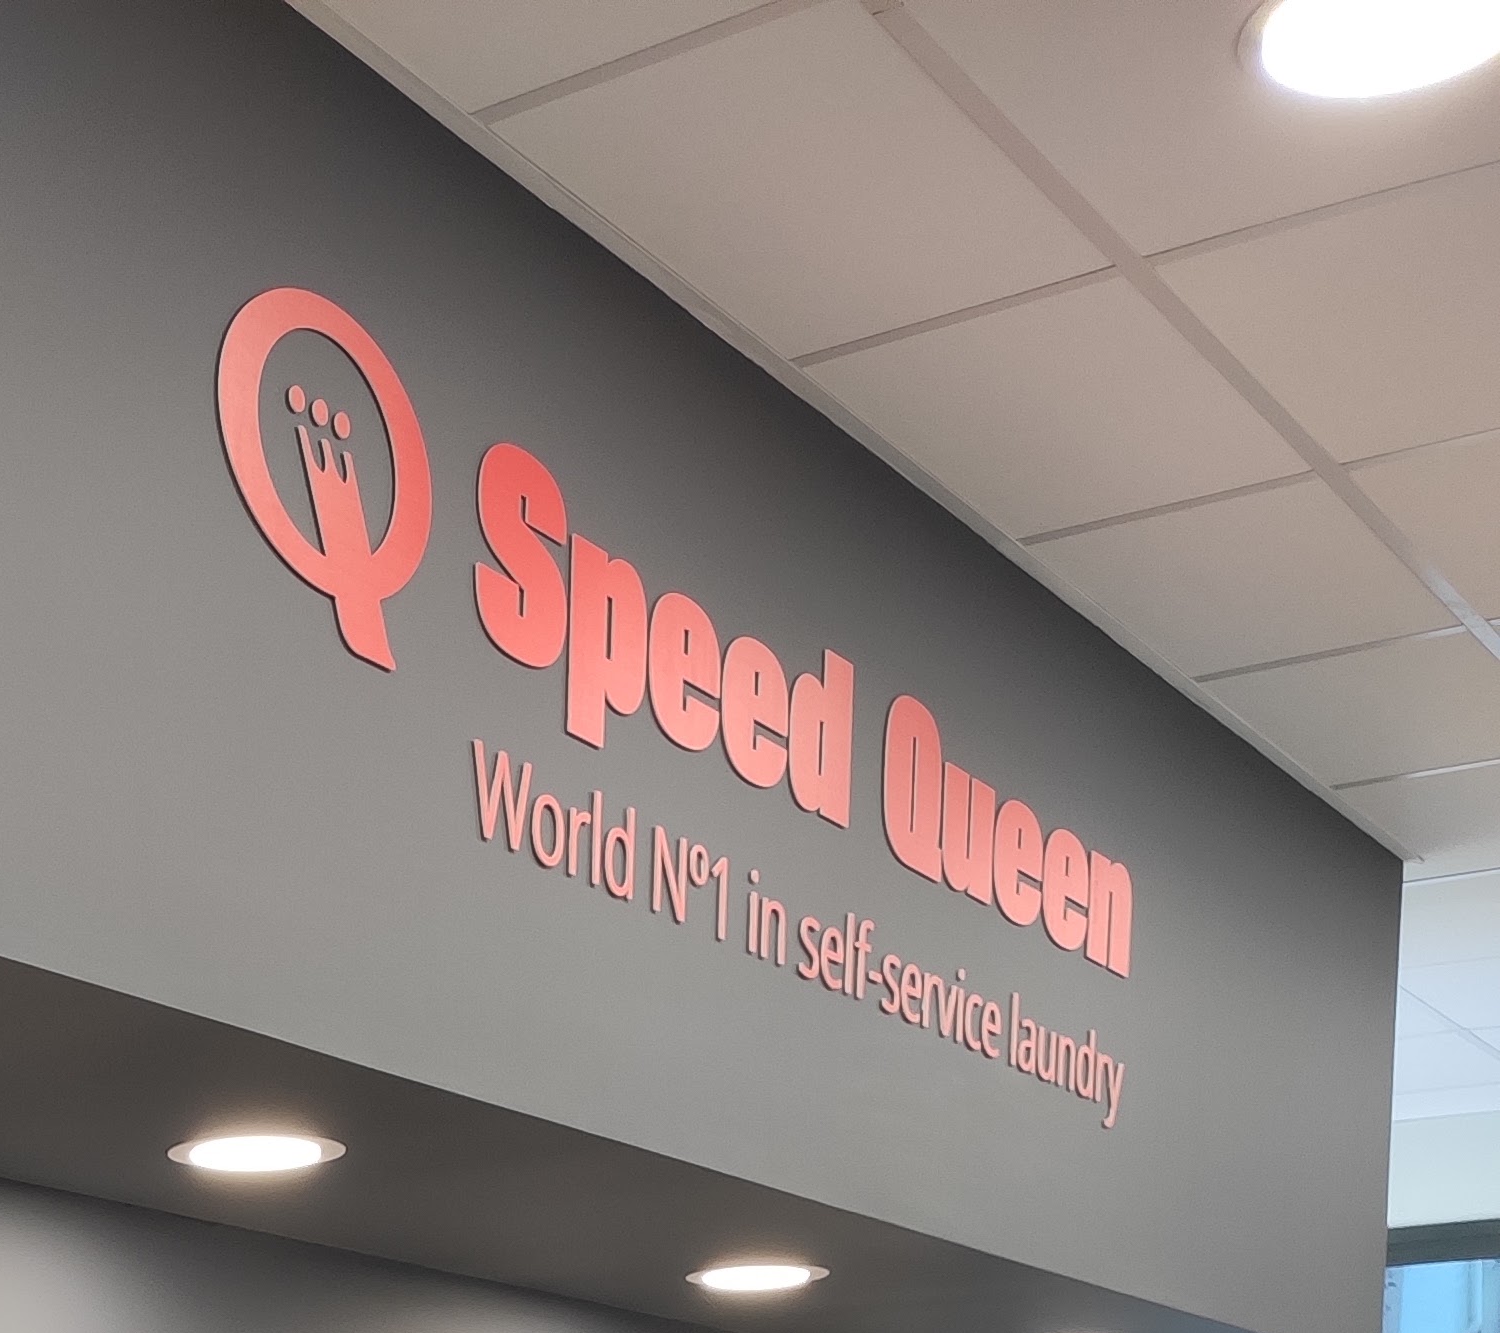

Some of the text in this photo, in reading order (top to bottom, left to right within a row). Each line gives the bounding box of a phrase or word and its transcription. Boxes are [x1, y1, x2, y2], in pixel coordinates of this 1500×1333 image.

[472, 738, 638, 900] World
[746, 869, 787, 965] in
[798, 912, 1001, 1058] self-service
[1010, 992, 1126, 1128] laundry
[474, 443, 1132, 978] Speed Queen
